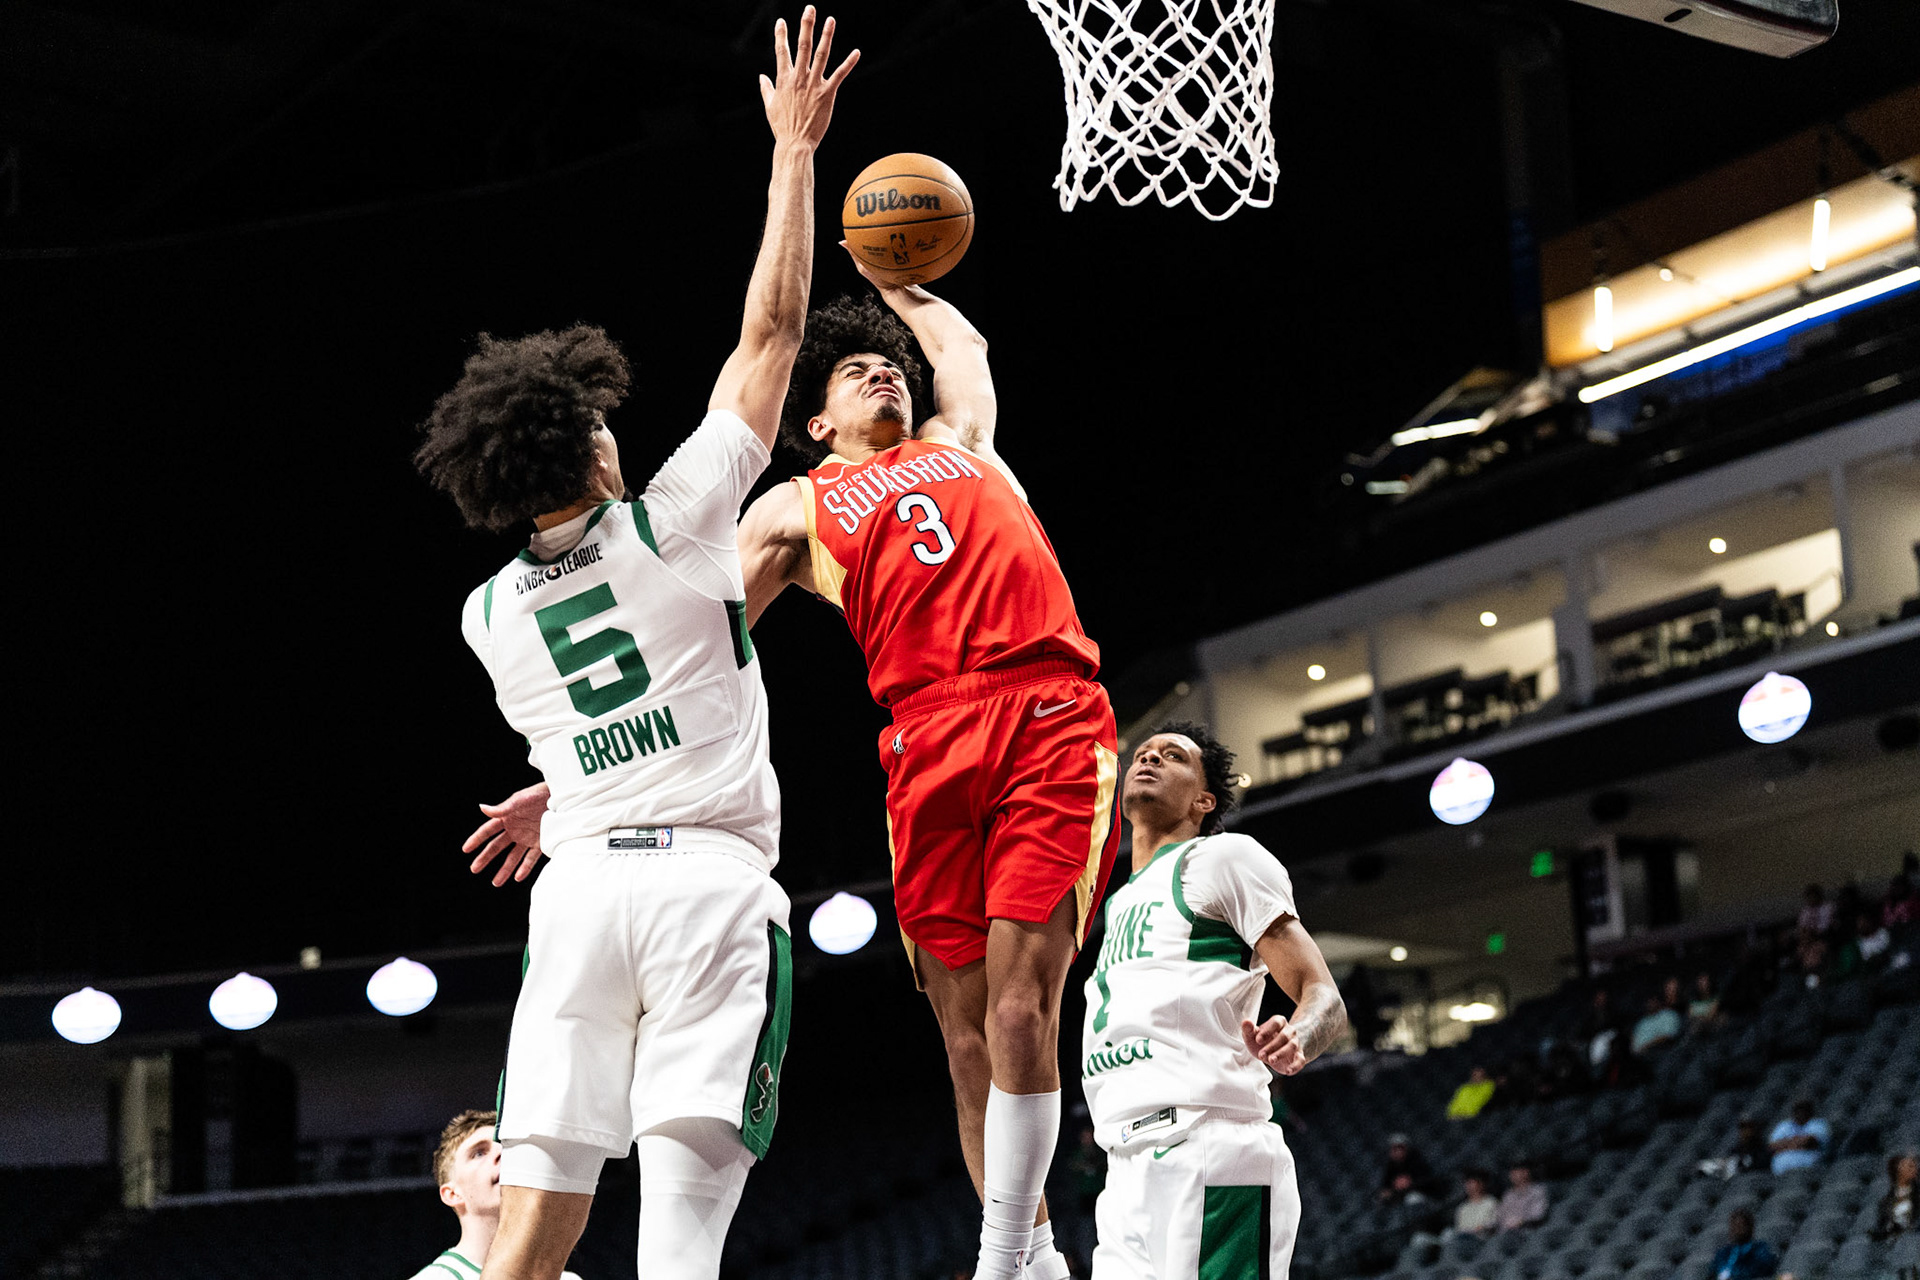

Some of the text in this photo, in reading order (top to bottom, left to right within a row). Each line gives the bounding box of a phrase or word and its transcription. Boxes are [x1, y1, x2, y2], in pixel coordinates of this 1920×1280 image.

[855, 188, 942, 217] Wilson
[823, 450, 983, 535] SQUADRON
[896, 492, 957, 566] 3
[524, 570, 546, 592] NBA
[561, 542, 604, 575] LEAGUE
[534, 581, 652, 719] 5
[572, 705, 681, 776] BROWN
[1083, 1038, 1154, 1080] mica
